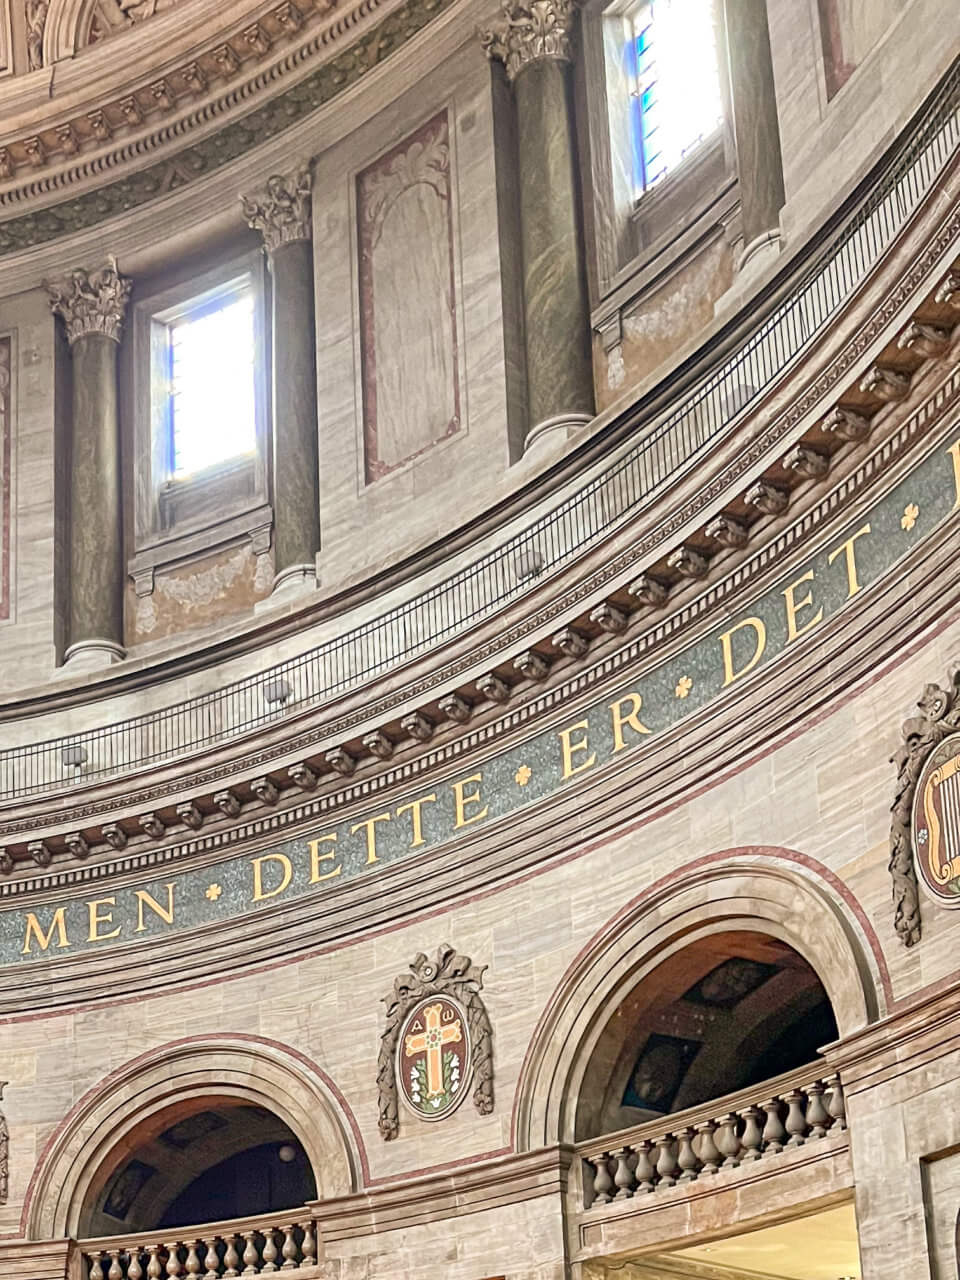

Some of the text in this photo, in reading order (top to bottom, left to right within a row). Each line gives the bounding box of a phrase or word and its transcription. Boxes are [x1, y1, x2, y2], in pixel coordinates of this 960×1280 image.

[21, 523, 872, 954] MEN DETTE ER DET
